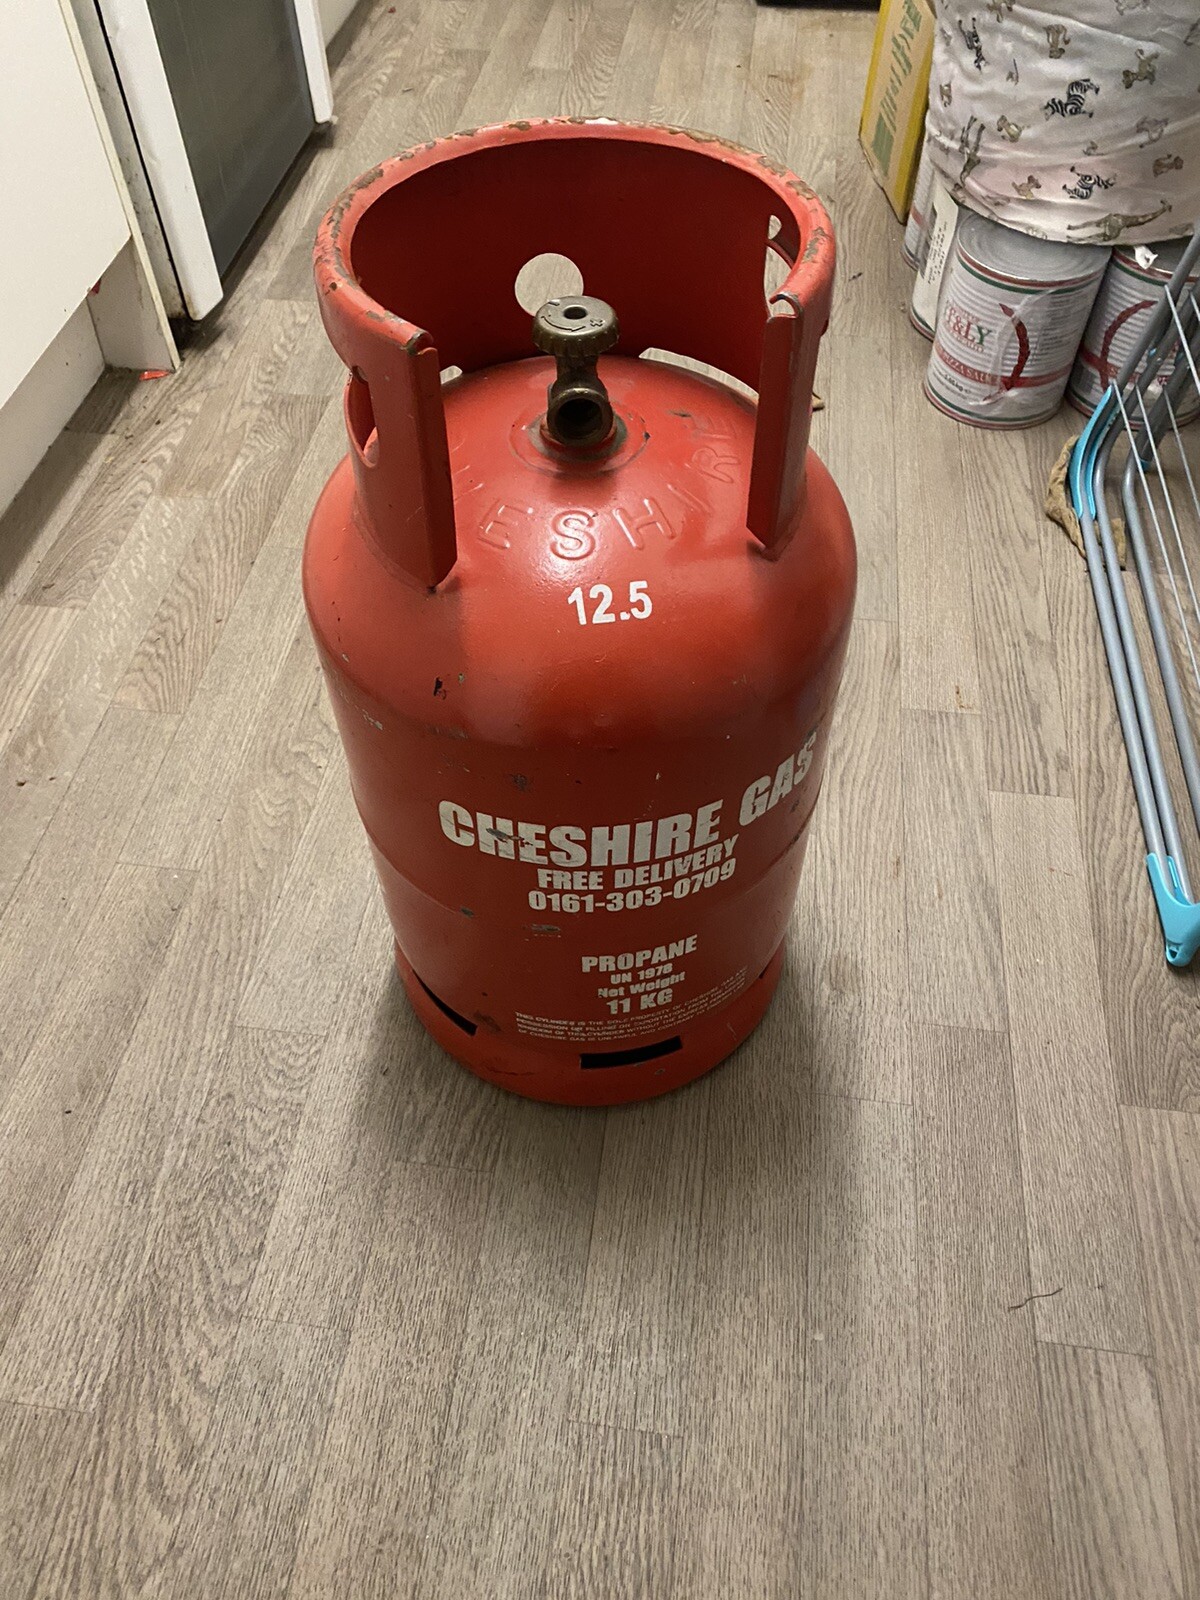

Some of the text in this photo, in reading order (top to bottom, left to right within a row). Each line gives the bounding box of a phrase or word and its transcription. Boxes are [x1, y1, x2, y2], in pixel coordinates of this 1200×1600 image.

[567, 580, 652, 625] 12.5
[438, 731, 816, 867] CHESHIRE GAS
[537, 834, 739, 890] FREE DELIVERY
[528, 858, 737, 913] 0161-303-0709
[581, 934, 698, 973] PROPANE
[610, 963, 673, 985] UN 1978
[597, 971, 686, 998] Net Weight
[606, 988, 673, 1015] 11 KG
